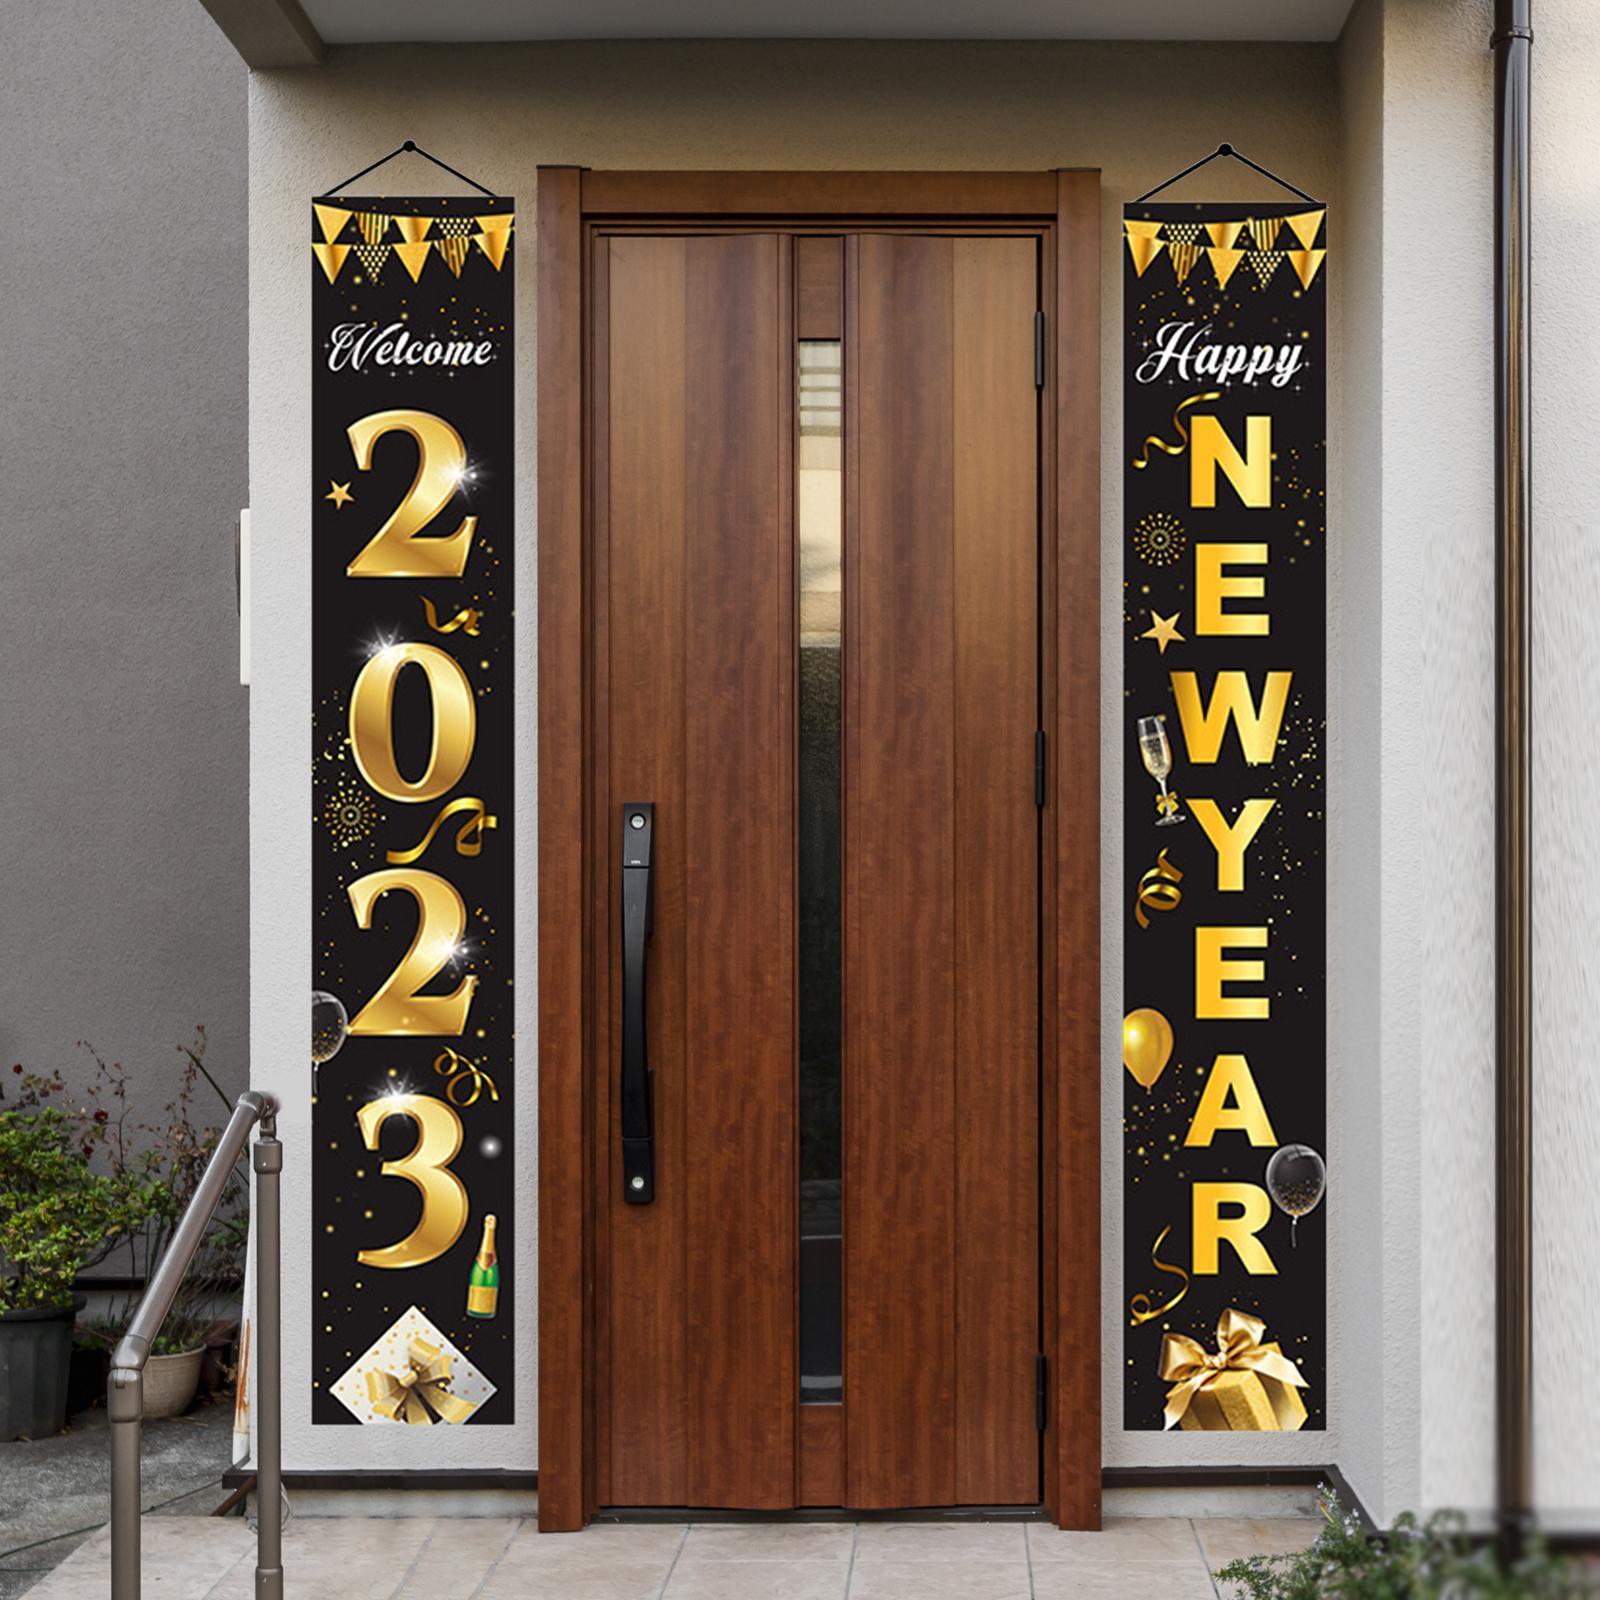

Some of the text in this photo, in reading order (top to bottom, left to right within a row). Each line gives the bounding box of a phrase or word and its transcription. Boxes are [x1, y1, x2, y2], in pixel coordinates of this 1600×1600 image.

[328, 322, 493, 372] Welcome
[1135, 321, 1302, 388] Happy
[346, 409, 479, 1269] 2023
